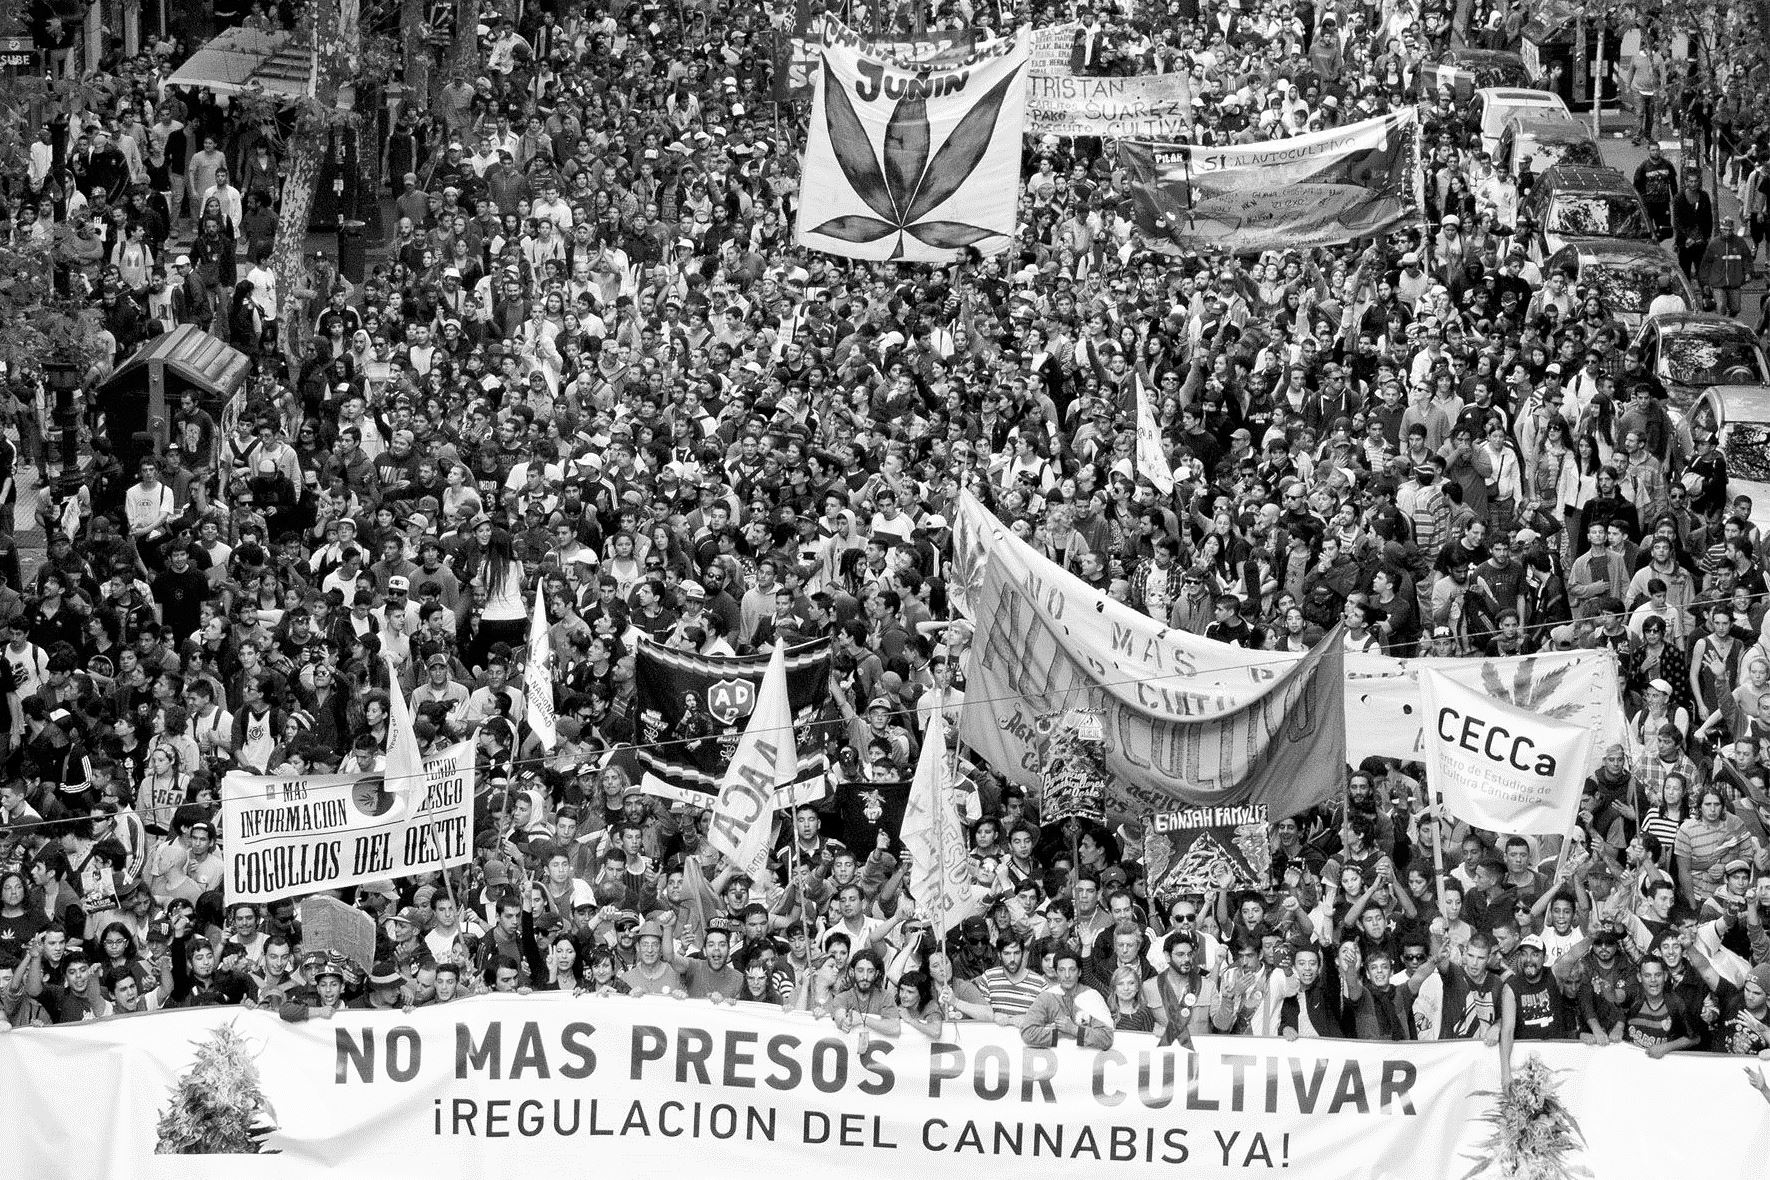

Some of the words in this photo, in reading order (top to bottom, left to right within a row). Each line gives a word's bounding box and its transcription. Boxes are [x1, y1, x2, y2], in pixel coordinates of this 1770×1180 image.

[1028, 75, 1124, 99] TRISTAN
[1085, 101, 1183, 121] SUAREZ
[1107, 118, 1191, 135] CULTIVA
[1251, 137, 1356, 164] AUTOCULTIVO
[1023, 571, 1066, 620] NO
[1438, 707, 1557, 777] CECCa
[283, 781, 307, 802] MAS
[416, 777, 464, 812] ESGO
[1484, 769, 1534, 793] Estudios
[240, 798, 348, 838] INFORMACION
[1155, 806, 1213, 833] GANJAH
[234, 840, 341, 894] COGOLLOS
[352, 831, 394, 876] DEL
[403, 815, 467, 867] OESTE
[334, 1025, 423, 1085] NO
[454, 1020, 598, 1081] MAS
[630, 1024, 896, 1097] PRESOS
[928, 1041, 1059, 1105] POR
[1092, 1047, 1418, 1117] CULTIVAR
[803, 1110, 898, 1150] DEL
[921, 1117, 1190, 1164] CANNABIS
[1214, 1129, 1290, 1169] YA!
